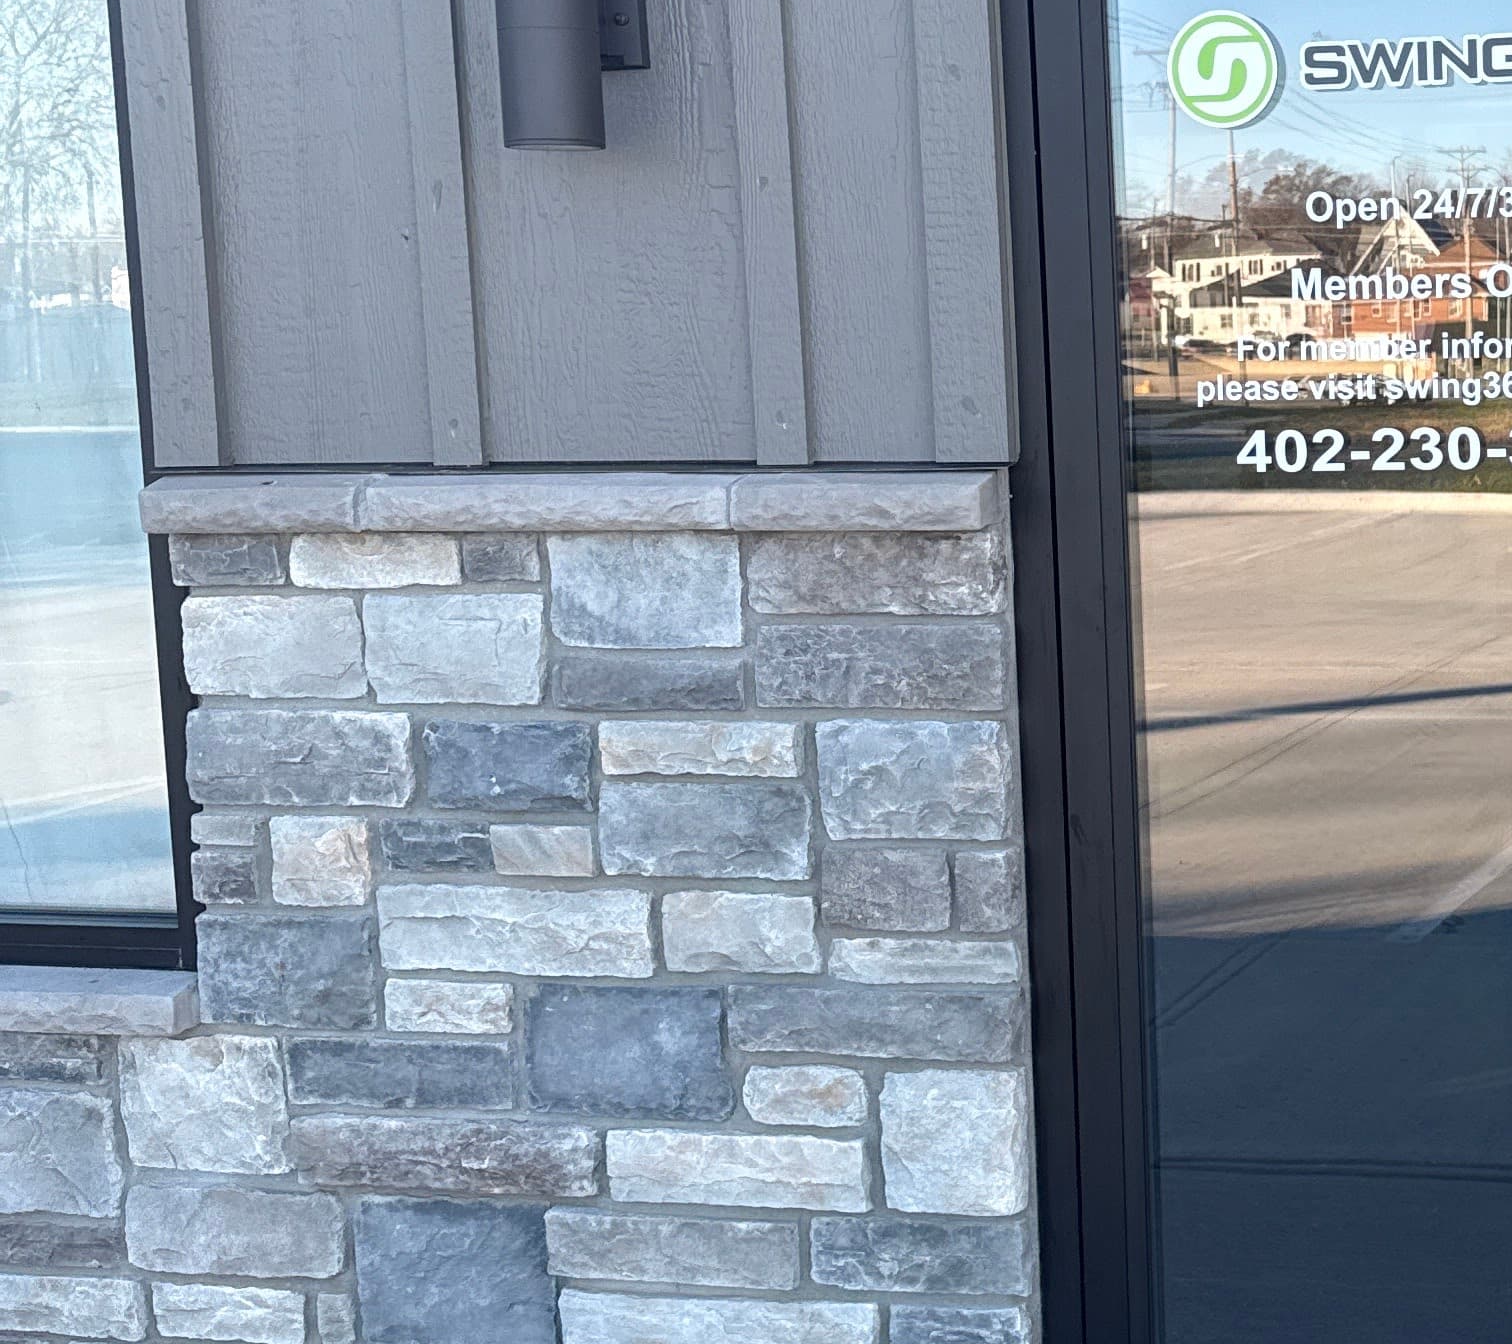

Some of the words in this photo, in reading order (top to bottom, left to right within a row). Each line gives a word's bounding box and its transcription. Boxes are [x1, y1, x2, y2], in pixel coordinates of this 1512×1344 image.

[1305, 190, 1401, 229] Open
[1290, 266, 1472, 302] Members
[1237, 335, 1291, 363] For
[1299, 333, 1432, 362] member
[1196, 373, 1299, 408] please
[1310, 373, 1377, 401] visit
